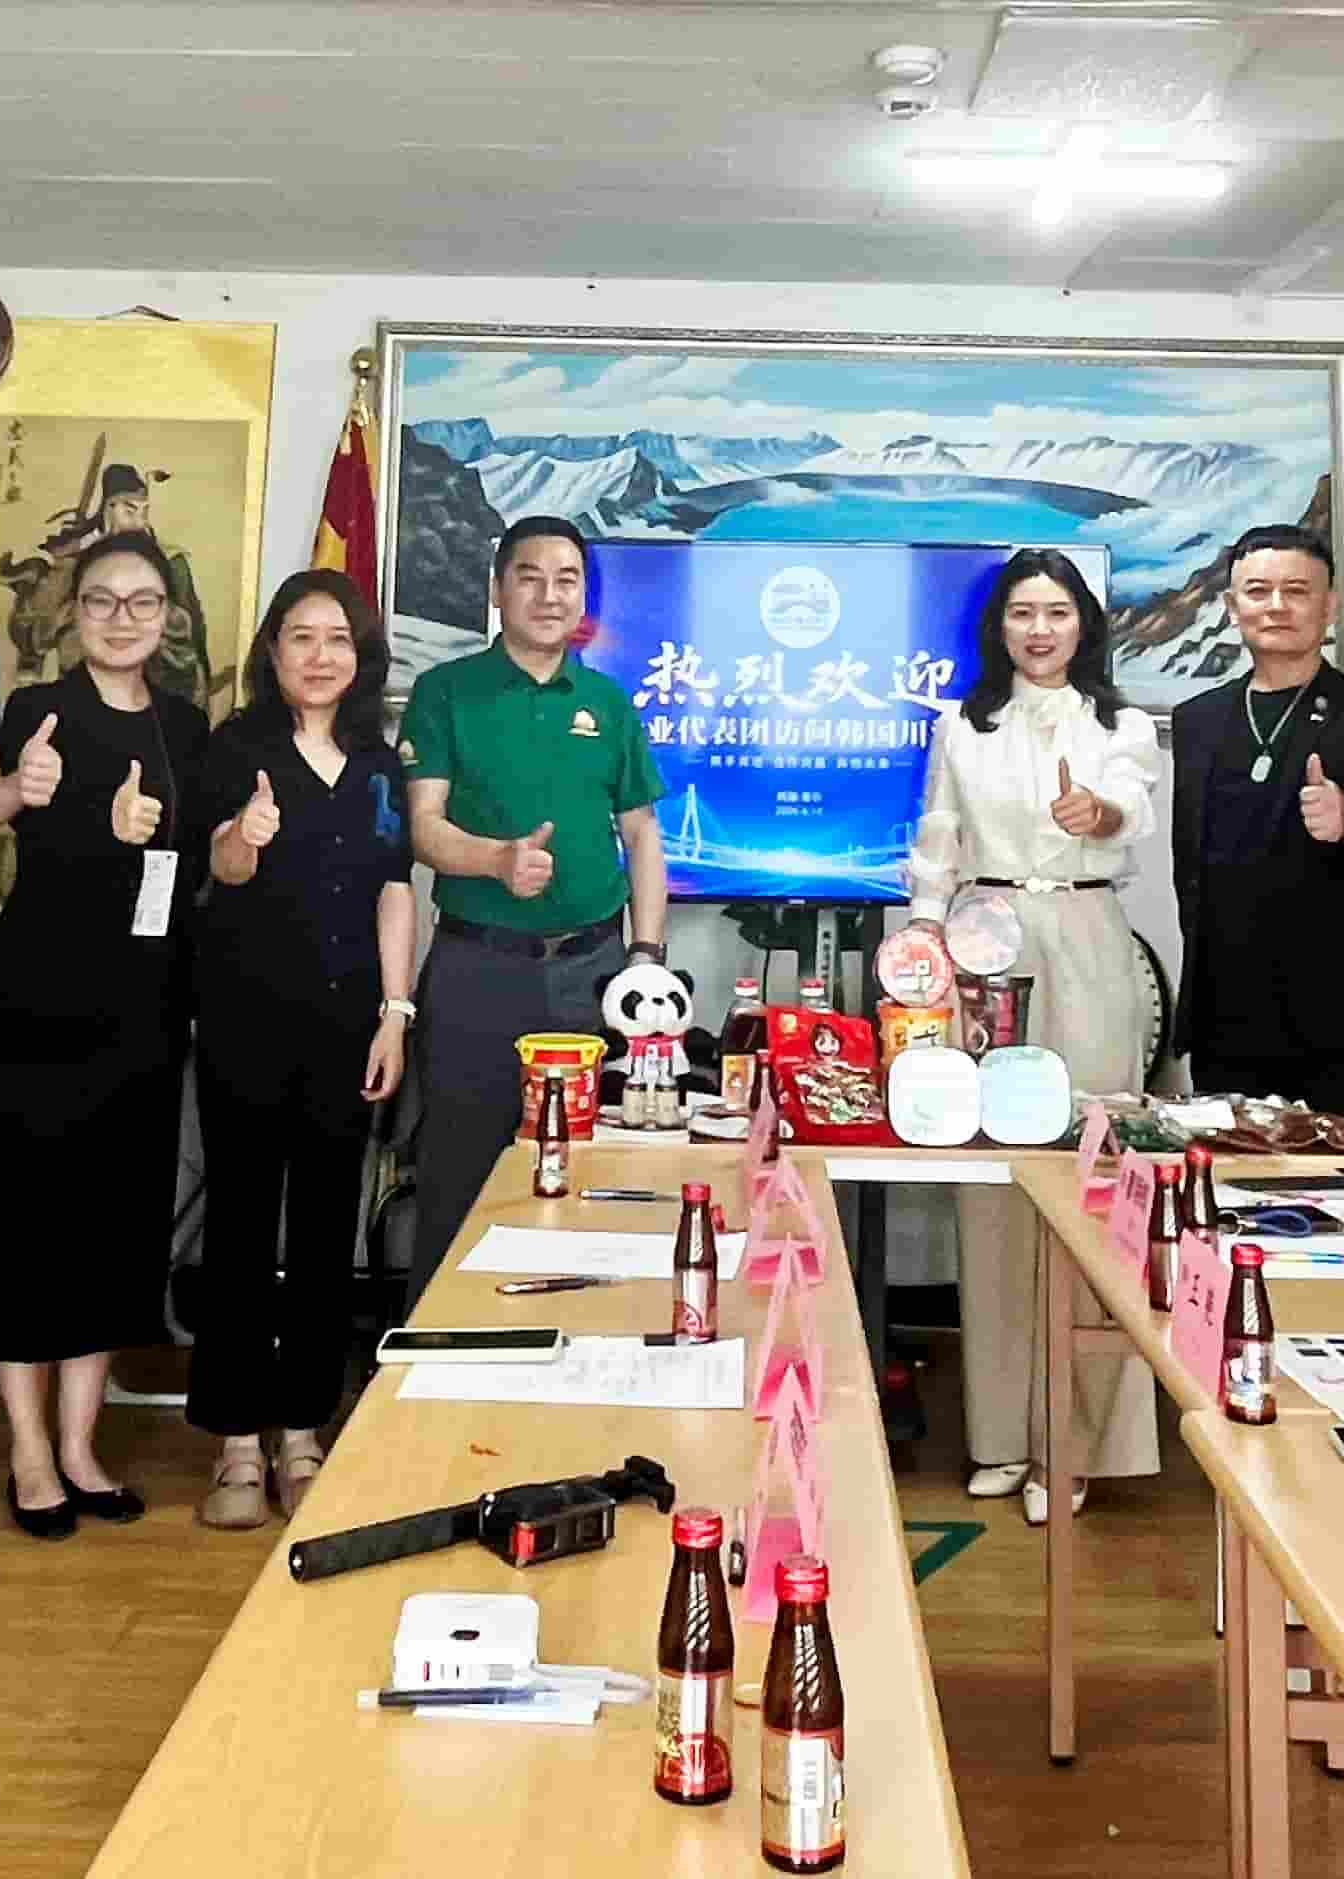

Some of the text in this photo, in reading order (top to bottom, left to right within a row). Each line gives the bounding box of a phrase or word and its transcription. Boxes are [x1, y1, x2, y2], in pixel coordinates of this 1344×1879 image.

[633, 641, 961, 711] 热烈欢迎
[642, 716, 937, 748] 业代表团访问韩国川
